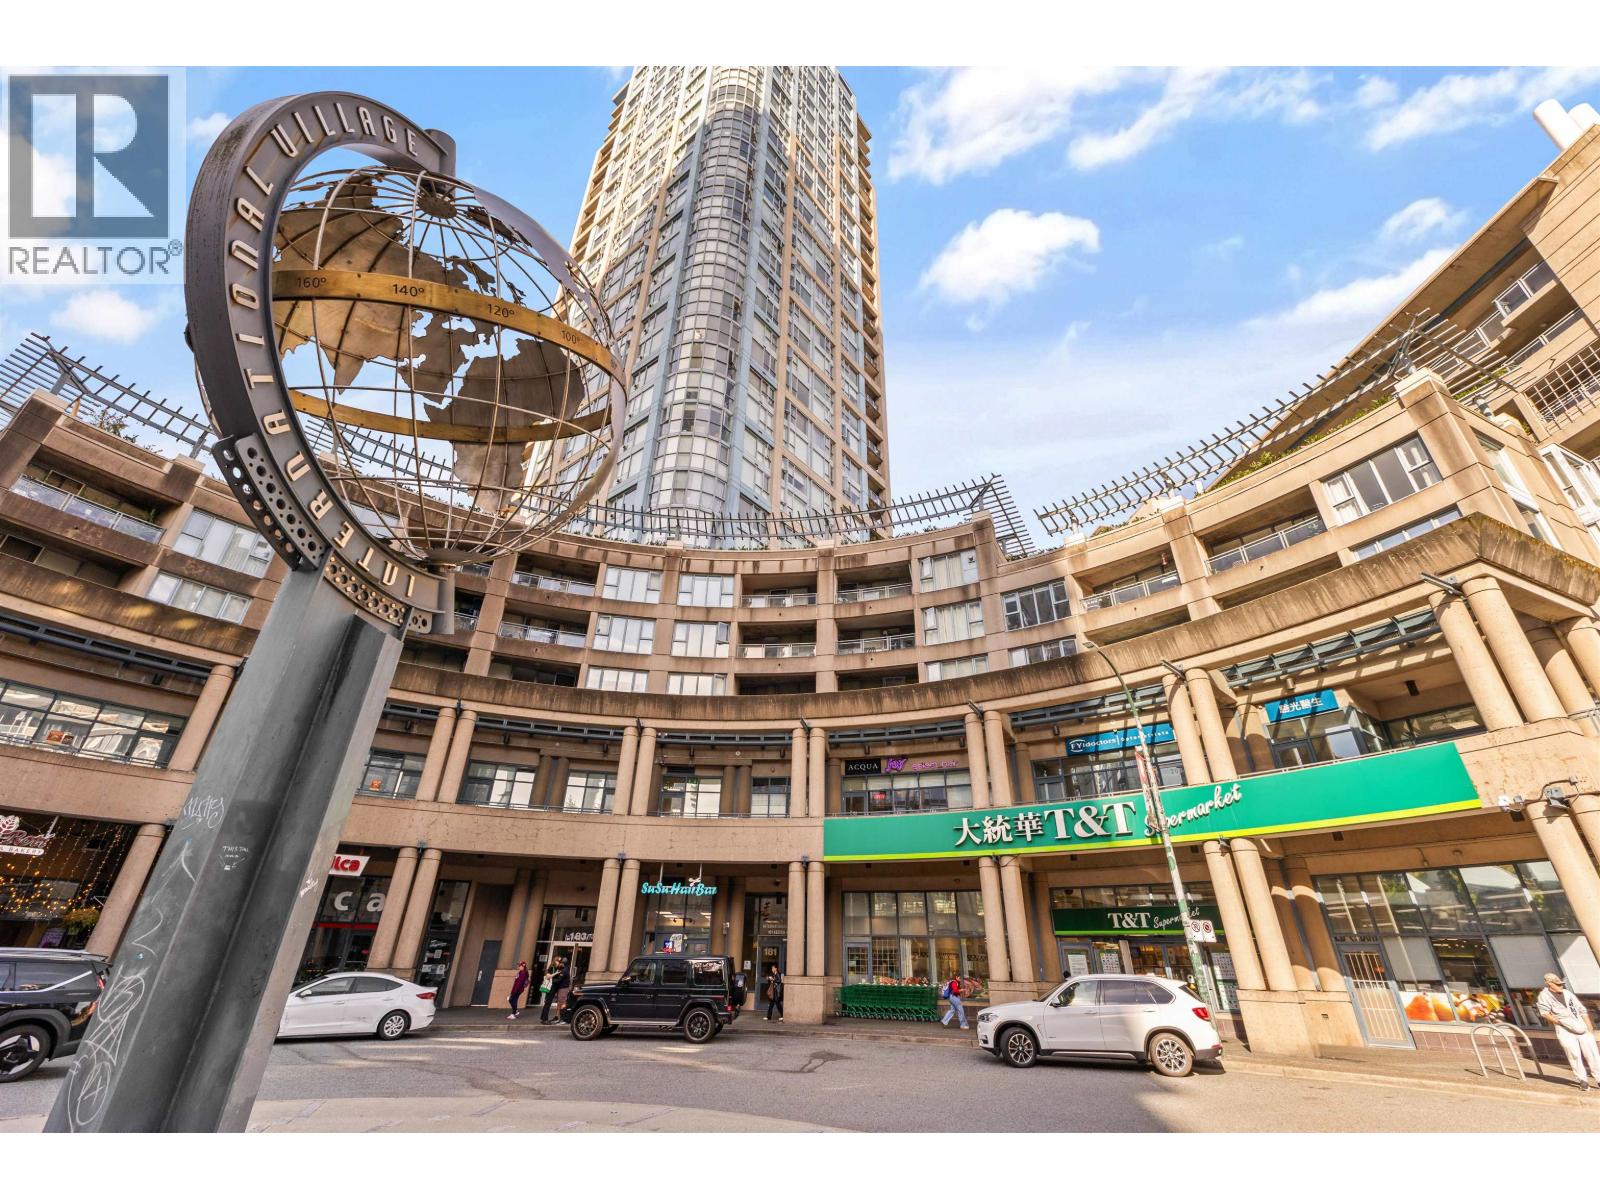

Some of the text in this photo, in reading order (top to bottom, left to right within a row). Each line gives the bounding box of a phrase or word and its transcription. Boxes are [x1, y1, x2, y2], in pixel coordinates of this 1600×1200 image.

[270, 103, 419, 158] VILLAGE
[1121, 730, 1170, 742] Optoetrists
[848, 763, 879, 771] ACQUA
[953, 783, 1242, 847] 大統華 T&T Sermarket
[1107, 907, 1200, 931] T&T Supermaet
